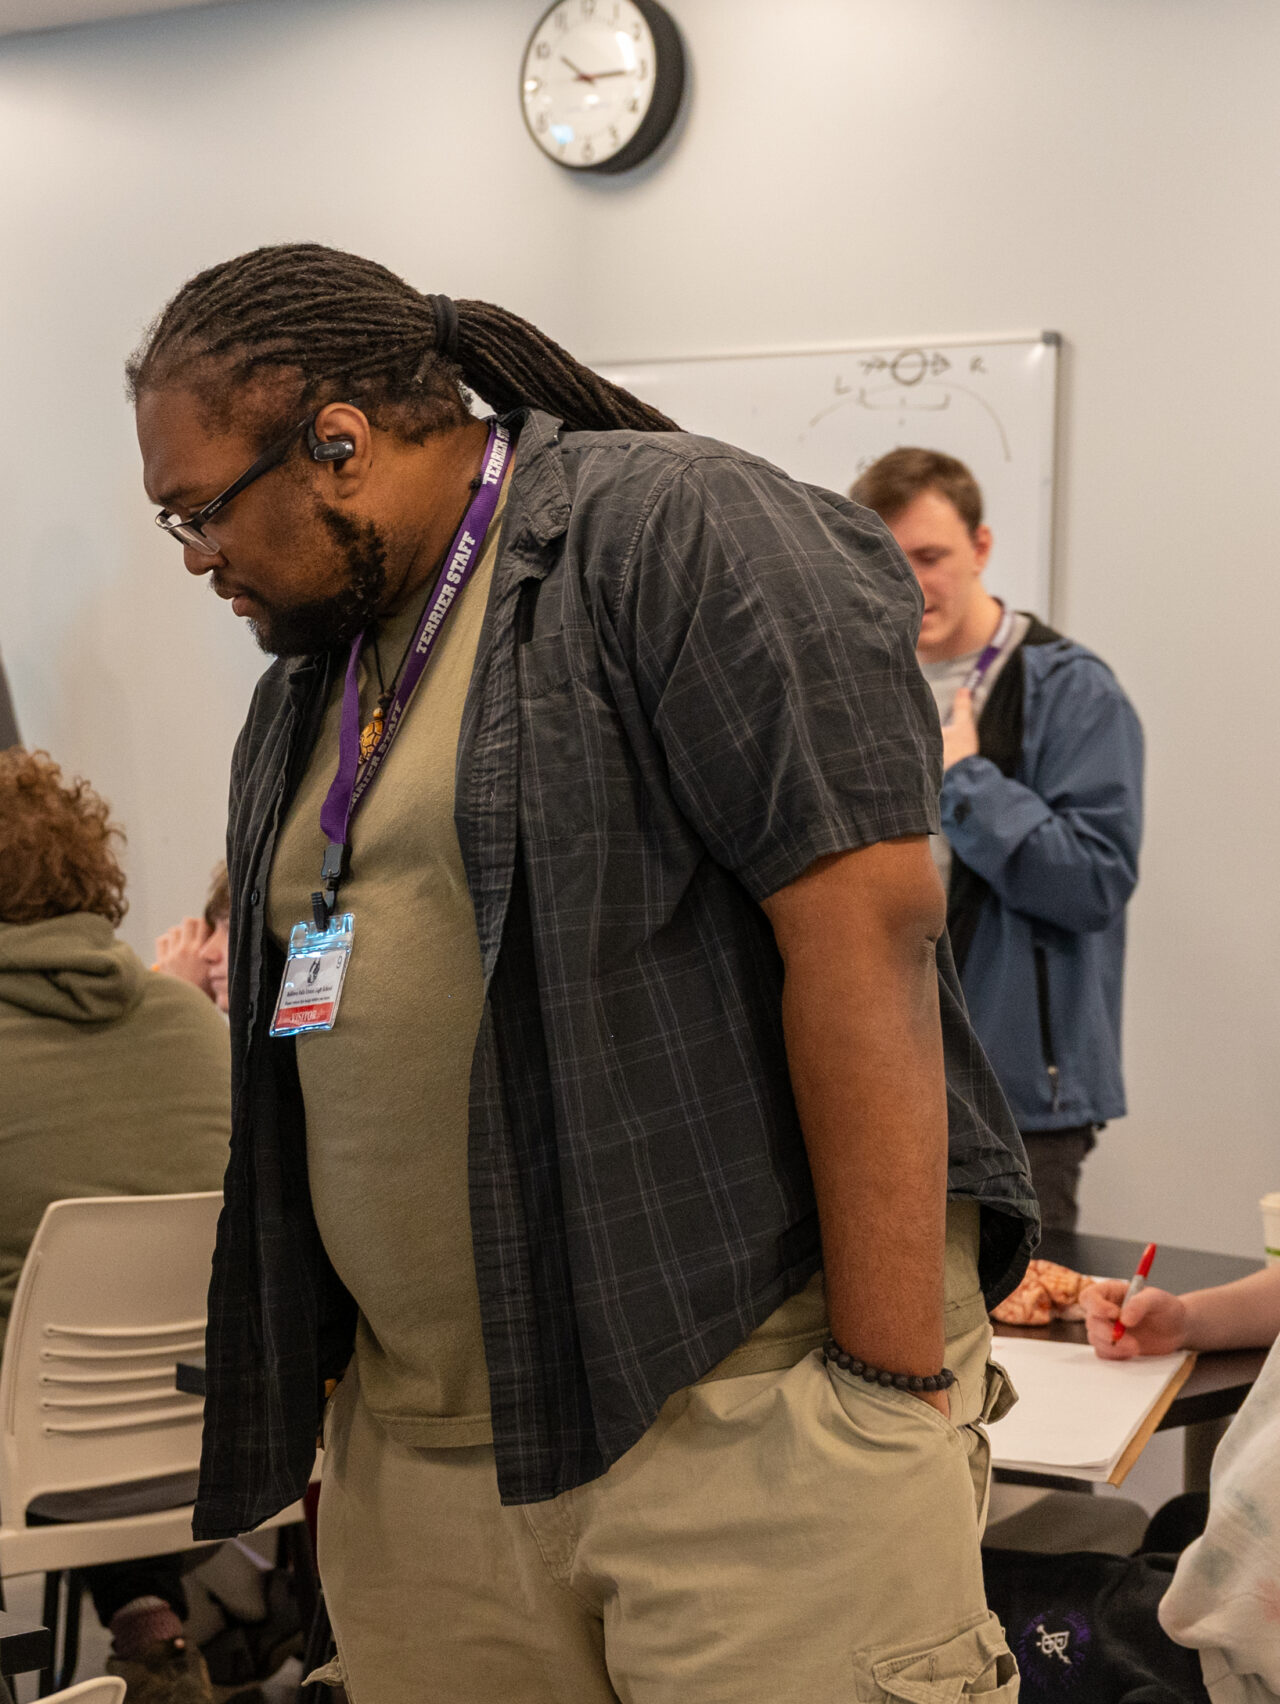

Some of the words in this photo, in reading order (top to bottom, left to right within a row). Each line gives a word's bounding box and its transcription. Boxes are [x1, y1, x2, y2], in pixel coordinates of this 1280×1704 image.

[482, 438, 509, 485] TERRIER
[416, 583, 457, 654] TERRIER
[446, 530, 476, 585] STAFF
[348, 755, 381, 814] ERRIER
[377, 699, 402, 754] STAFF
